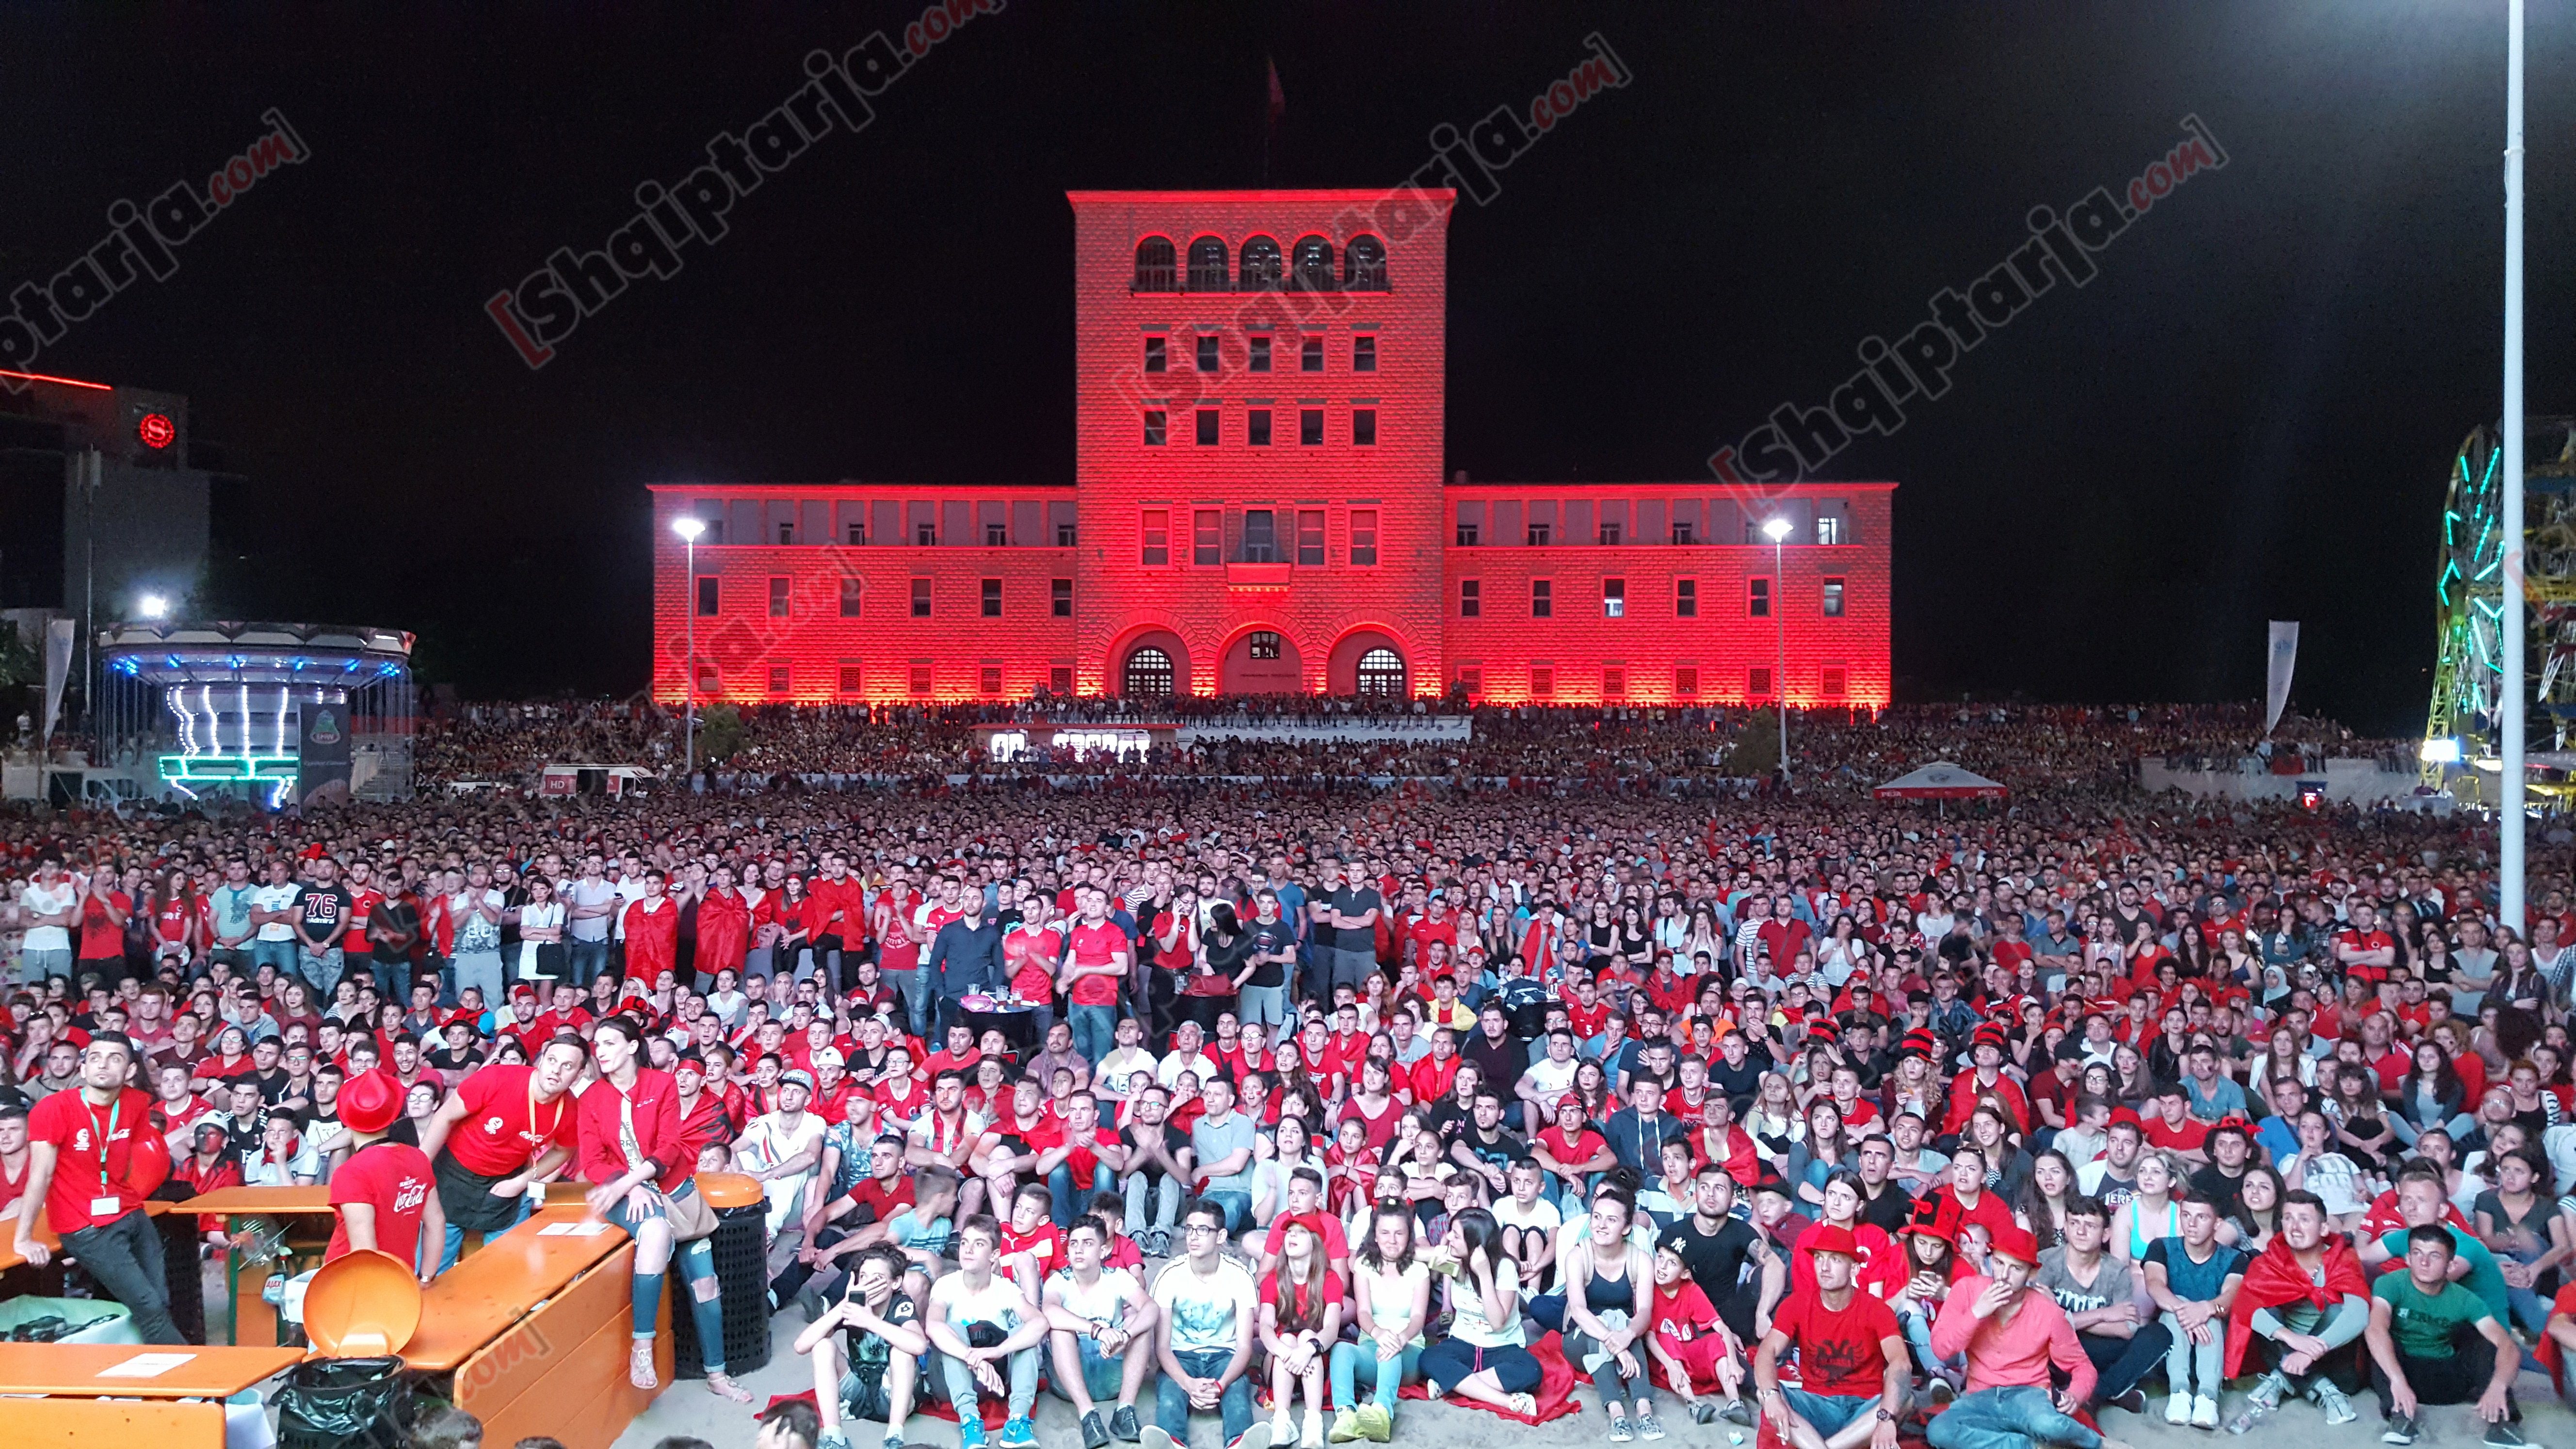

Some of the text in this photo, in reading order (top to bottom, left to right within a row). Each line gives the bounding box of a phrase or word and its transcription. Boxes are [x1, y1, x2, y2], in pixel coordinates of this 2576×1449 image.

[550, 780, 565, 789] HD
[305, 893, 338, 918] 76
[1586, 1024, 1593, 1036] 5
[1671, 1237, 1687, 1254] NY
[266, 1280, 282, 1288] AJAX
